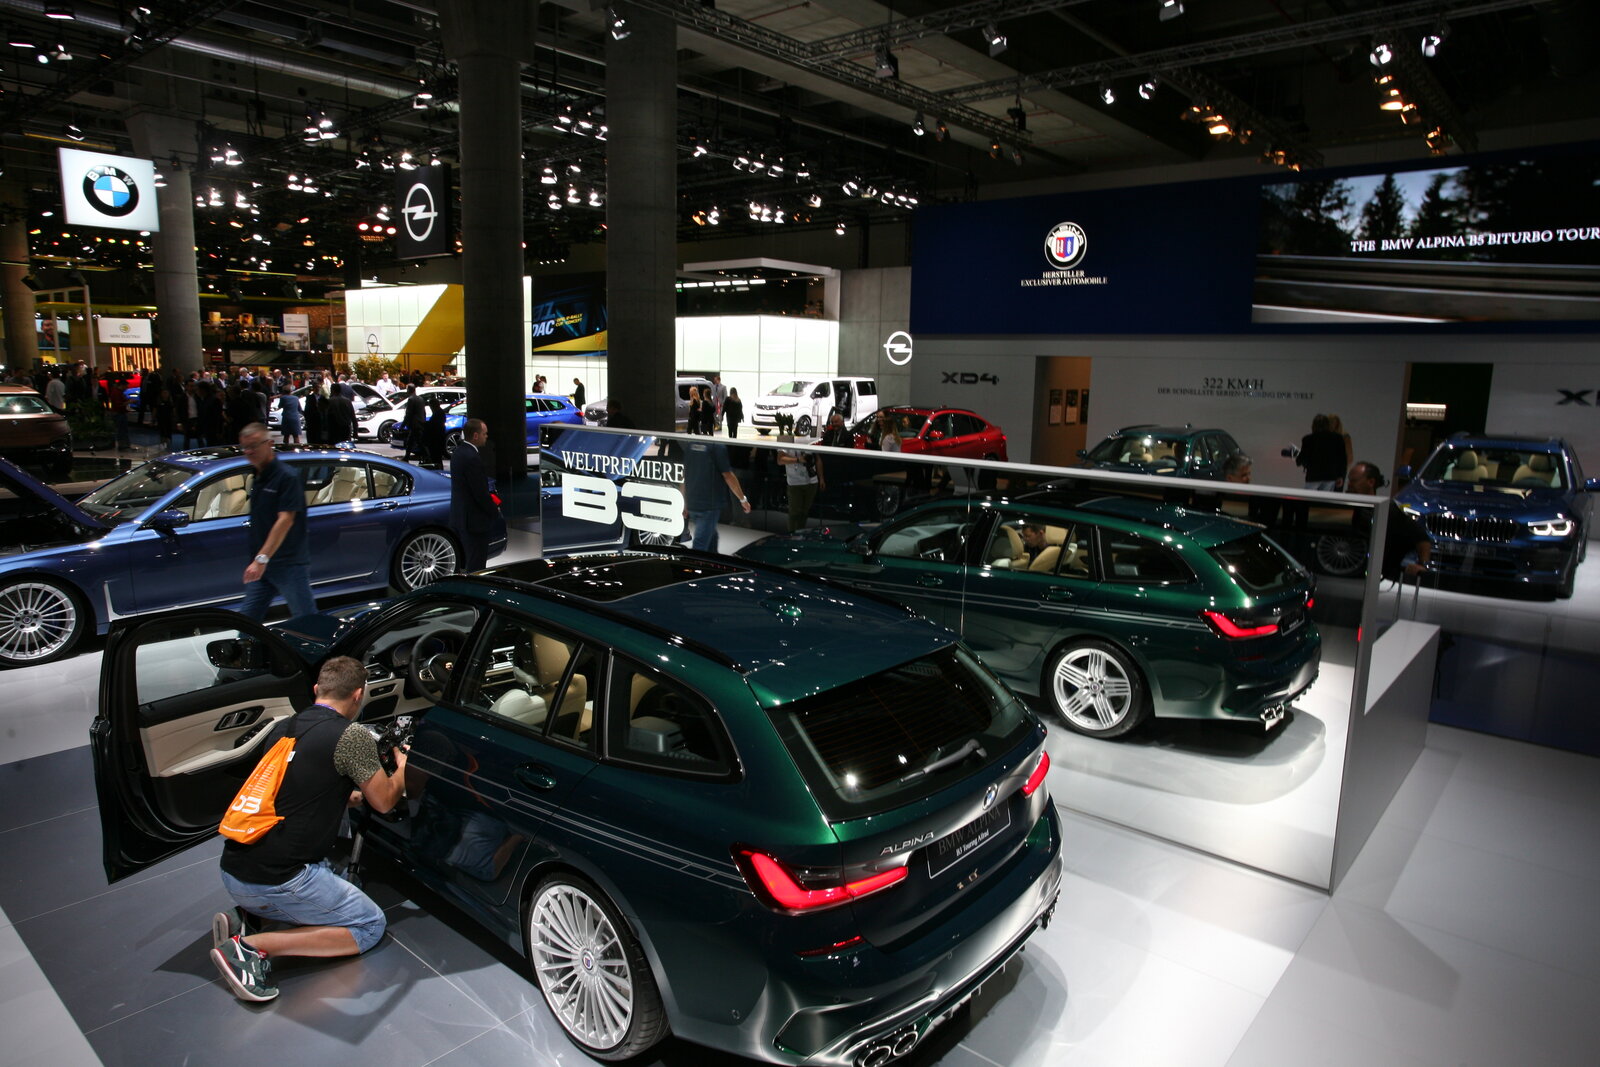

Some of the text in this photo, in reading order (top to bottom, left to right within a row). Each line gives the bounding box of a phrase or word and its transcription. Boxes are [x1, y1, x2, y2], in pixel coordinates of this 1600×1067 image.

[86, 166, 135, 186] BMW
[1350, 240, 1376, 252] THE
[1381, 238, 1414, 251] BMW
[1416, 235, 1466, 249] ALPINA
[1487, 229, 1553, 245] BITURBO
[1556, 227, 1600, 242] TOUR
[1020, 277, 1109, 287] EXCLUSIVER AUTOMOBILE
[1042, 270, 1085, 278] HERSTELLER
[942, 371, 999, 385] XD4
[1203, 377, 1264, 390] 322 KM/H
[1157, 387, 1171, 395] DER
[1172, 388, 1214, 397] SCHNELLSTE
[1294, 391, 1315, 400] WELT
[561, 450, 685, 484] WELTPREMIERE
[561, 473, 685, 537] B3
[938, 806, 1001, 856] BMW ALPINA
[880, 831, 934, 856] ALPINA
